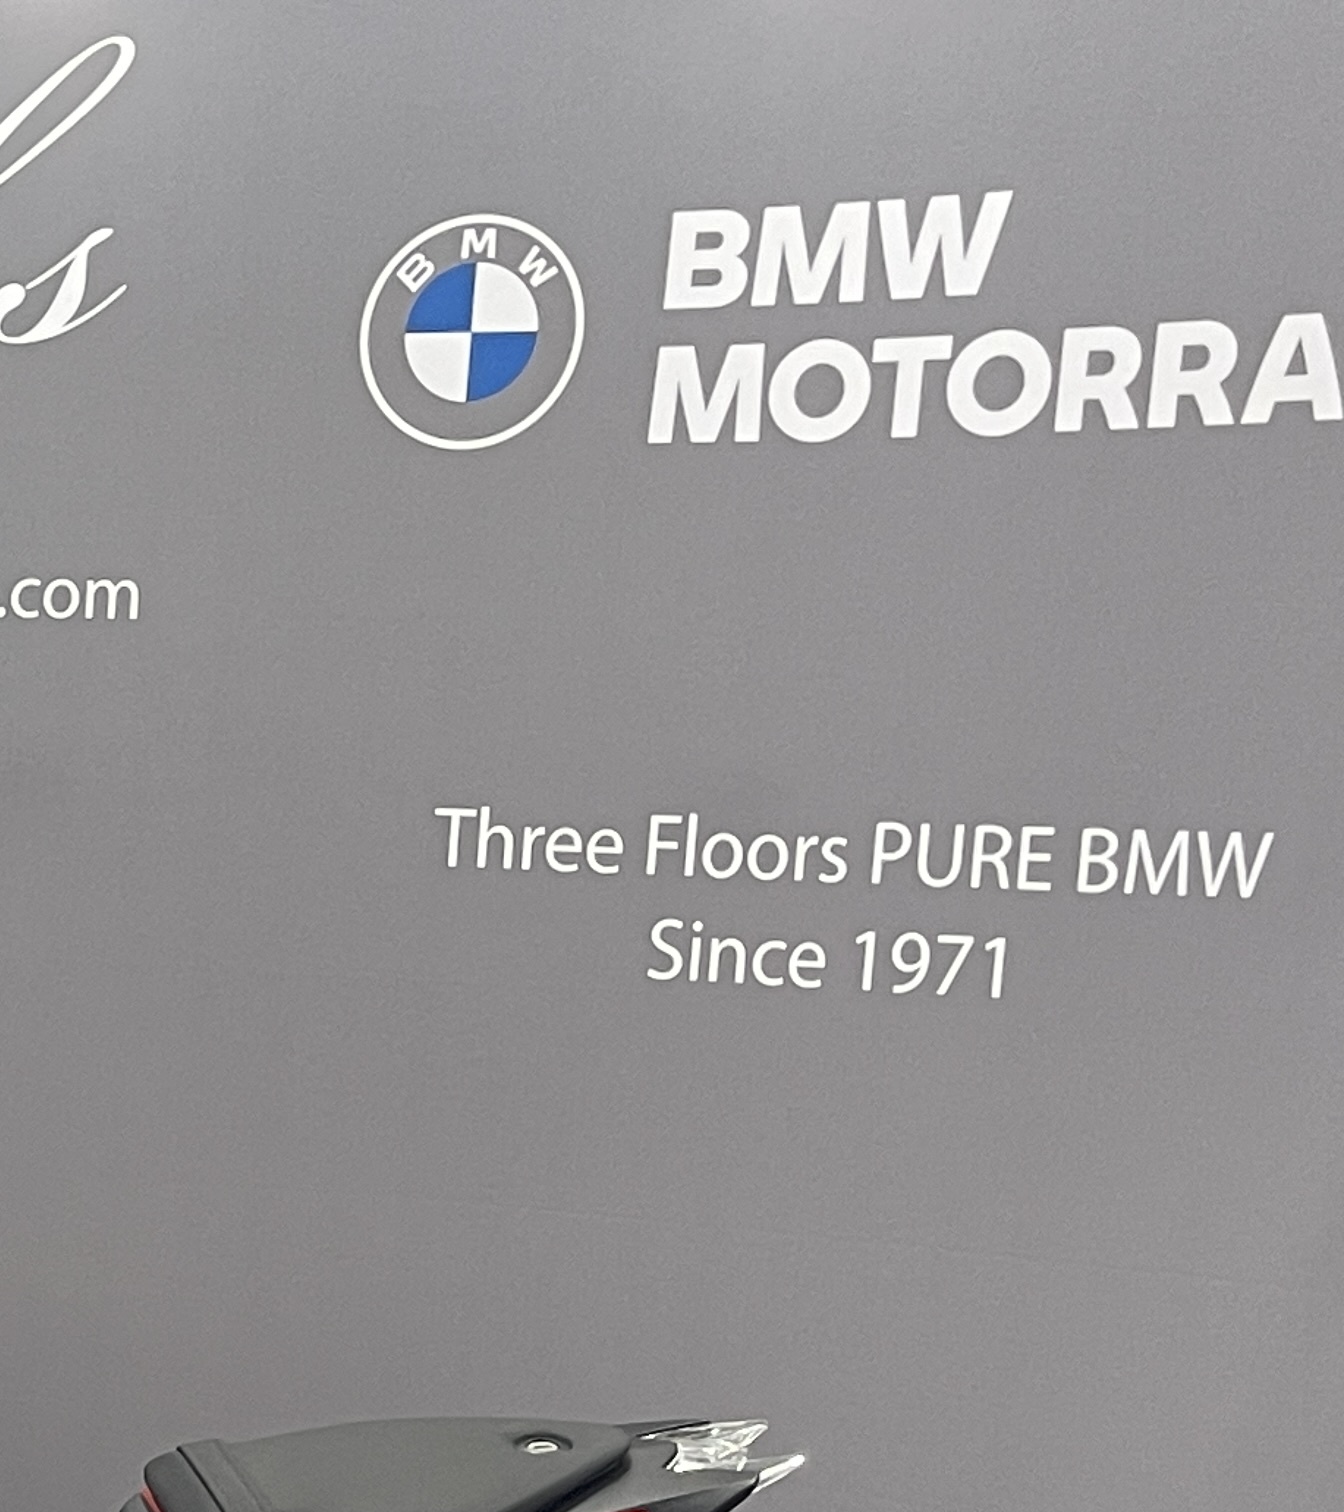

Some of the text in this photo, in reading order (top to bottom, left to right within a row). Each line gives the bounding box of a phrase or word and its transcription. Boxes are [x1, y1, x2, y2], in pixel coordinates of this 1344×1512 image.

[396, 227, 559, 293] BMW
[663, 189, 1014, 310] BMW
[433, 806, 1275, 900] Three Floors PURE BMW
[646, 918, 1007, 999] Since 1971
